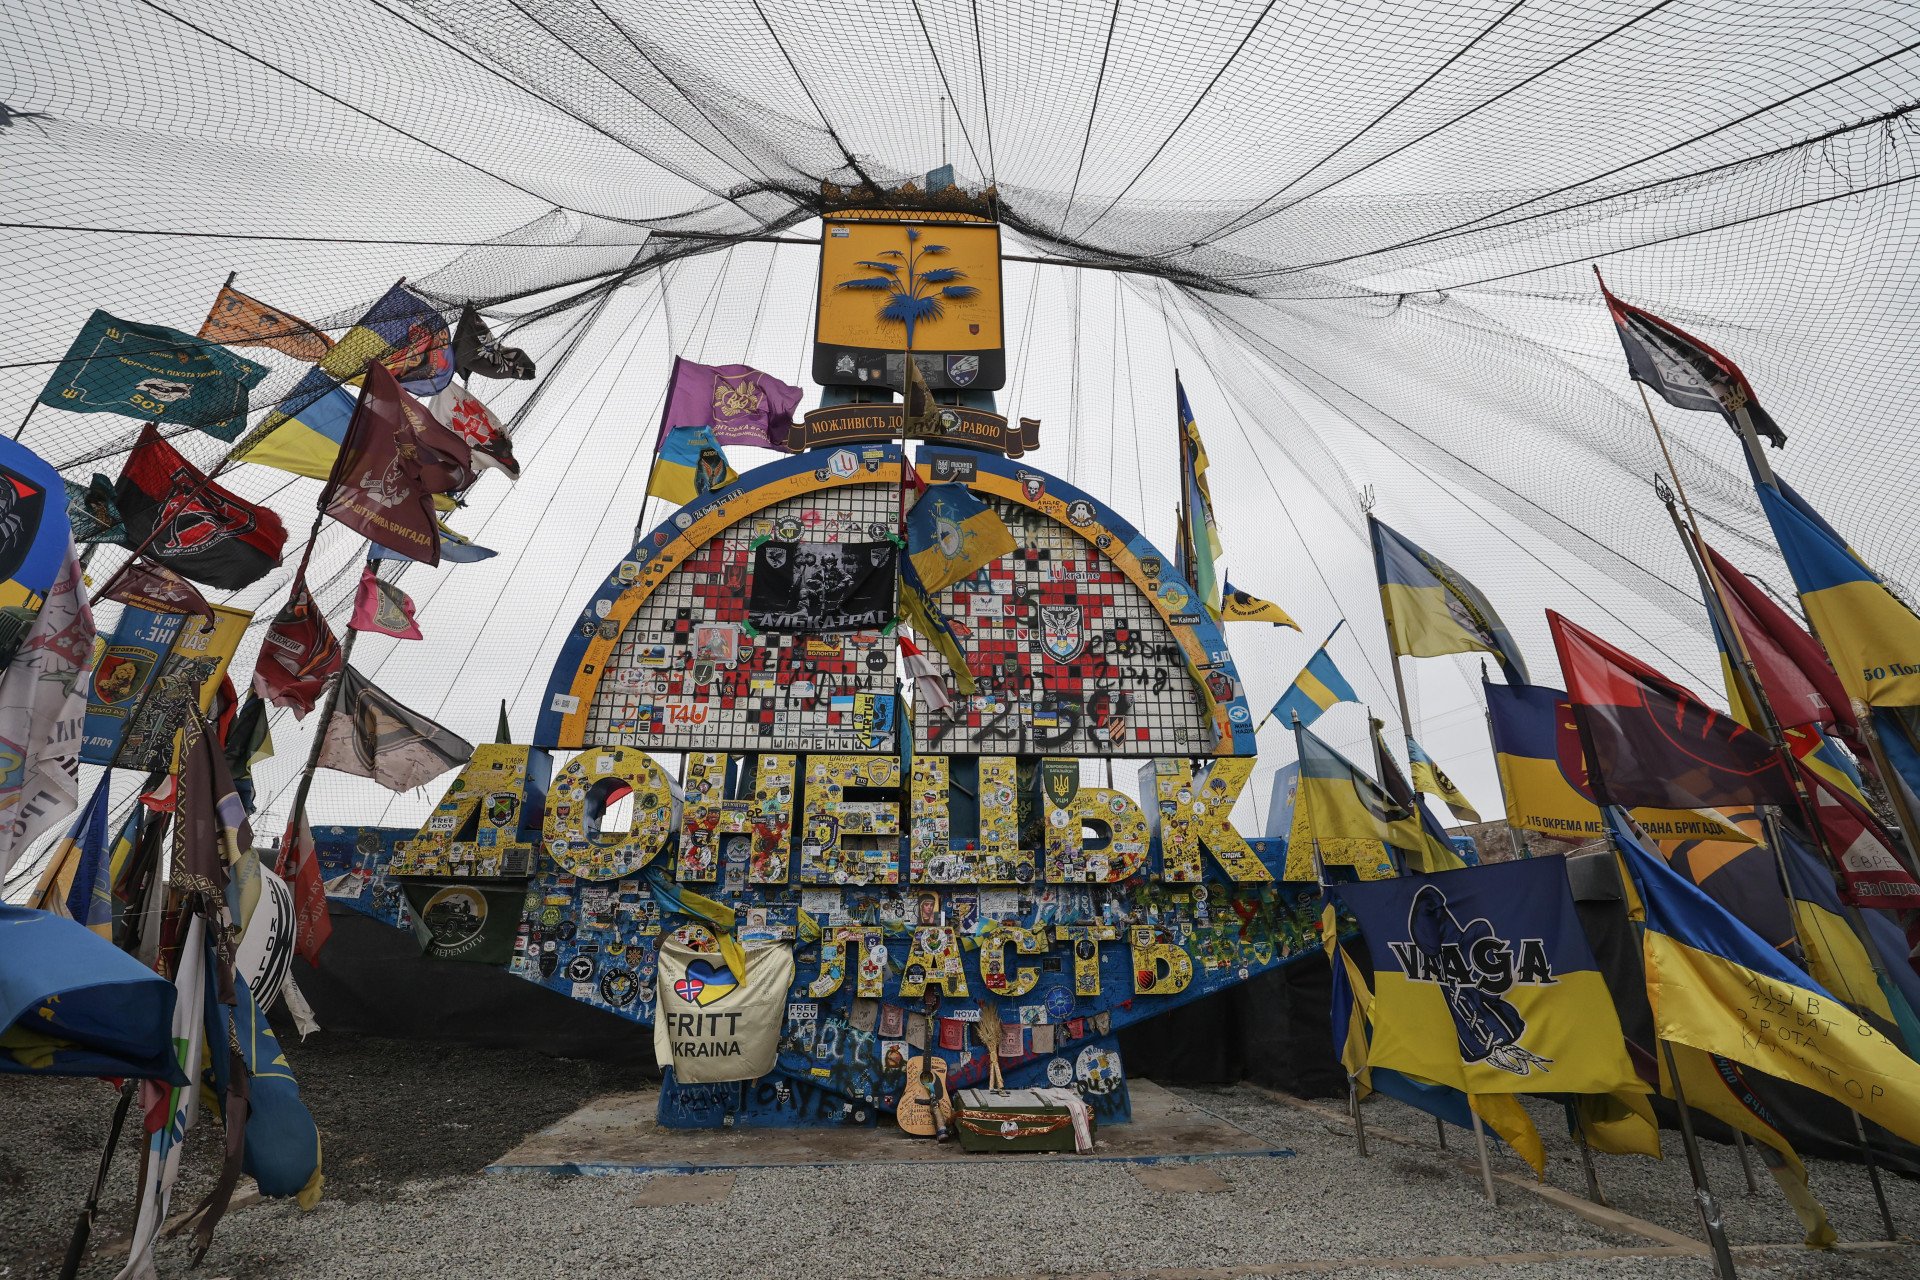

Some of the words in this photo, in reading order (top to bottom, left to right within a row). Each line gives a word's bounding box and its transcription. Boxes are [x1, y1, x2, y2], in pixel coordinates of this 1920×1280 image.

[129, 393, 166, 415] 503
[811, 415, 886, 435] МОЖЛИВІСТЬ
[389, 519, 432, 547] БРИГАДА
[758, 610, 889, 629] АЛЬКАТРАС
[1863, 667, 1886, 682] 50
[1526, 815, 1541, 828] 115
[1543, 817, 1582, 832] ОКРЕМА
[1674, 821, 1726, 837] БРИГАДА
[955, 1010, 977, 1018] NOVA
[1750, 994, 1788, 1018] 122
[667, 1012, 743, 1037] FRITT
[1759, 1019, 1823, 1055] РОТА
[671, 1040, 742, 1058] KRAINA
